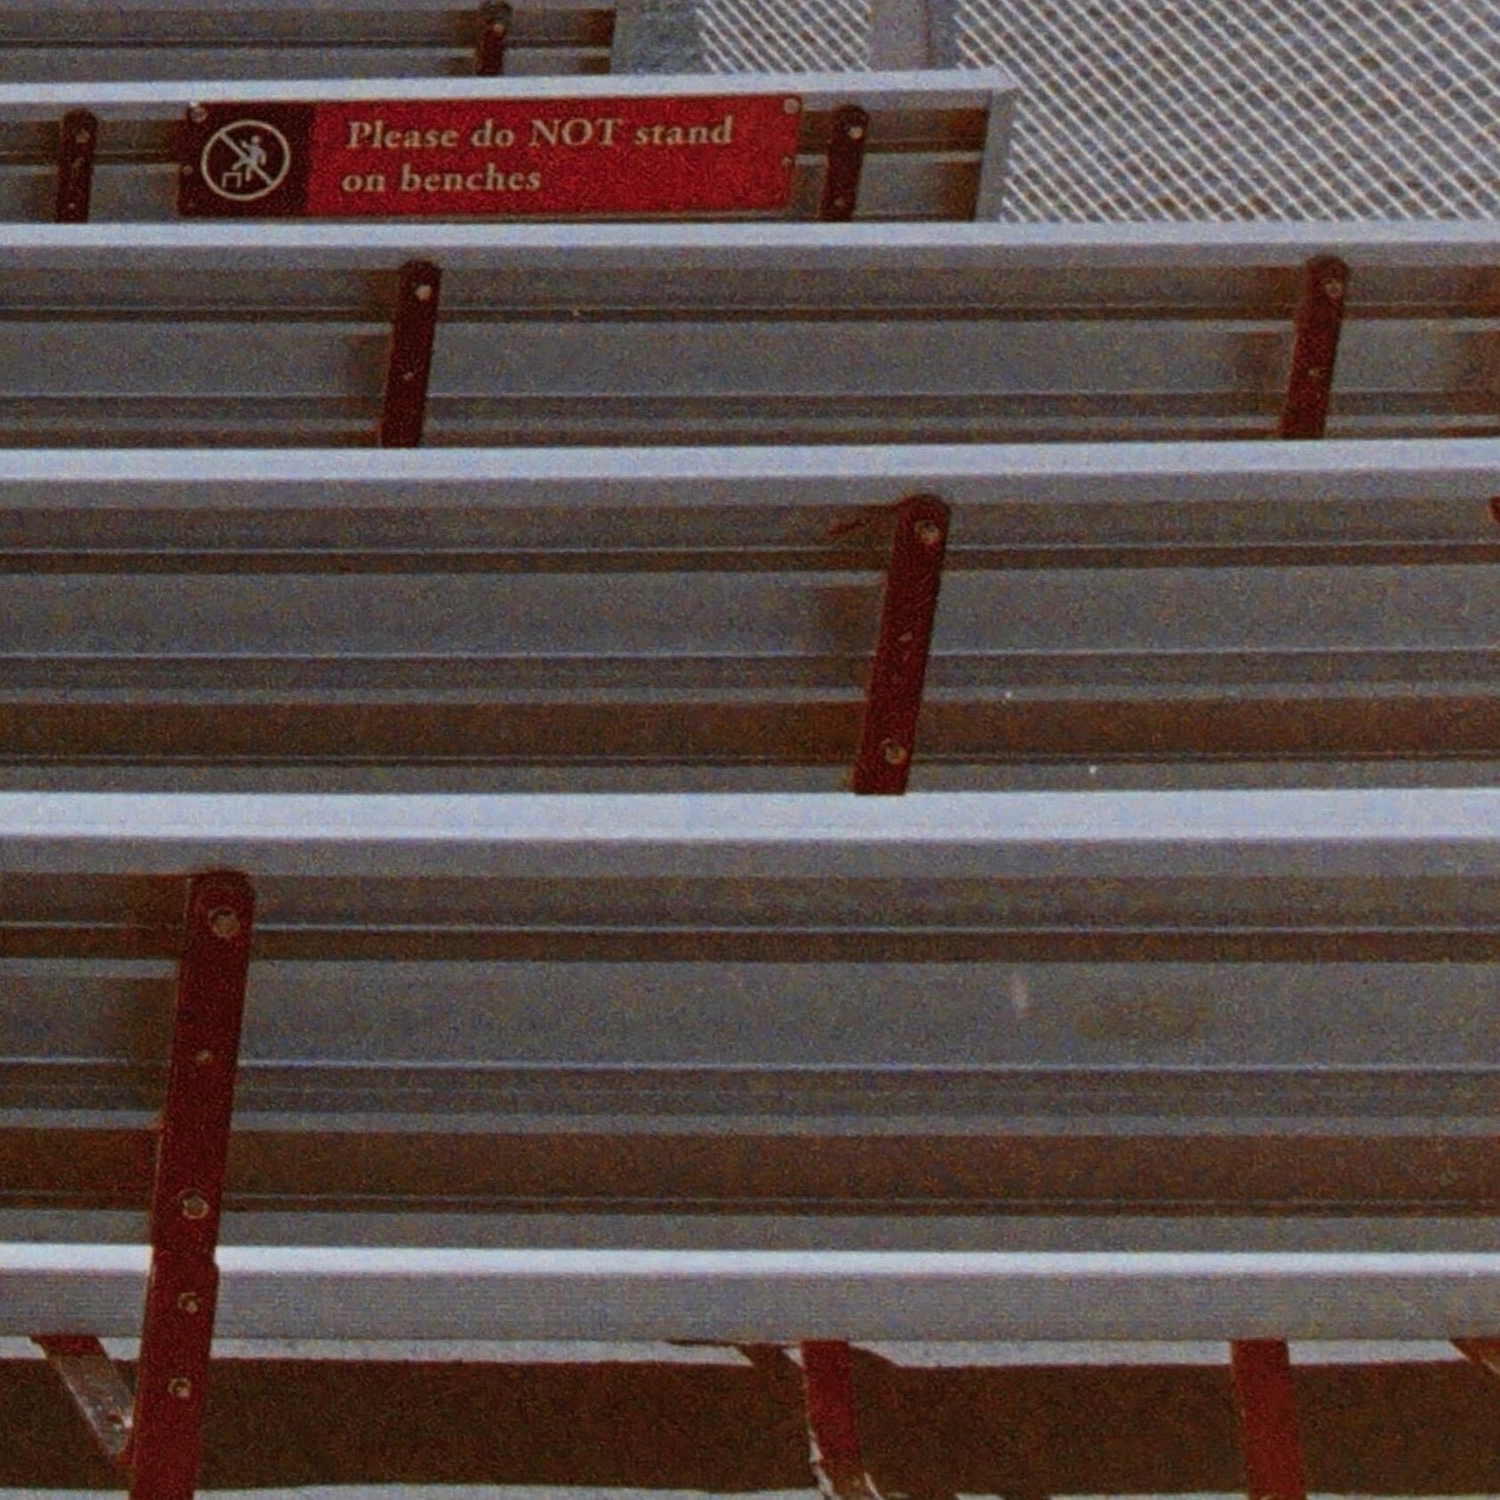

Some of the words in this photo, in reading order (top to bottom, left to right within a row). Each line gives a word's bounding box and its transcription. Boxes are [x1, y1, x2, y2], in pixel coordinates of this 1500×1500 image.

[346, 119, 457, 150] Please
[471, 118, 515, 148] do
[528, 117, 622, 148] NOT
[634, 115, 733, 146] stand
[341, 169, 387, 193] on
[399, 162, 542, 193] benches
